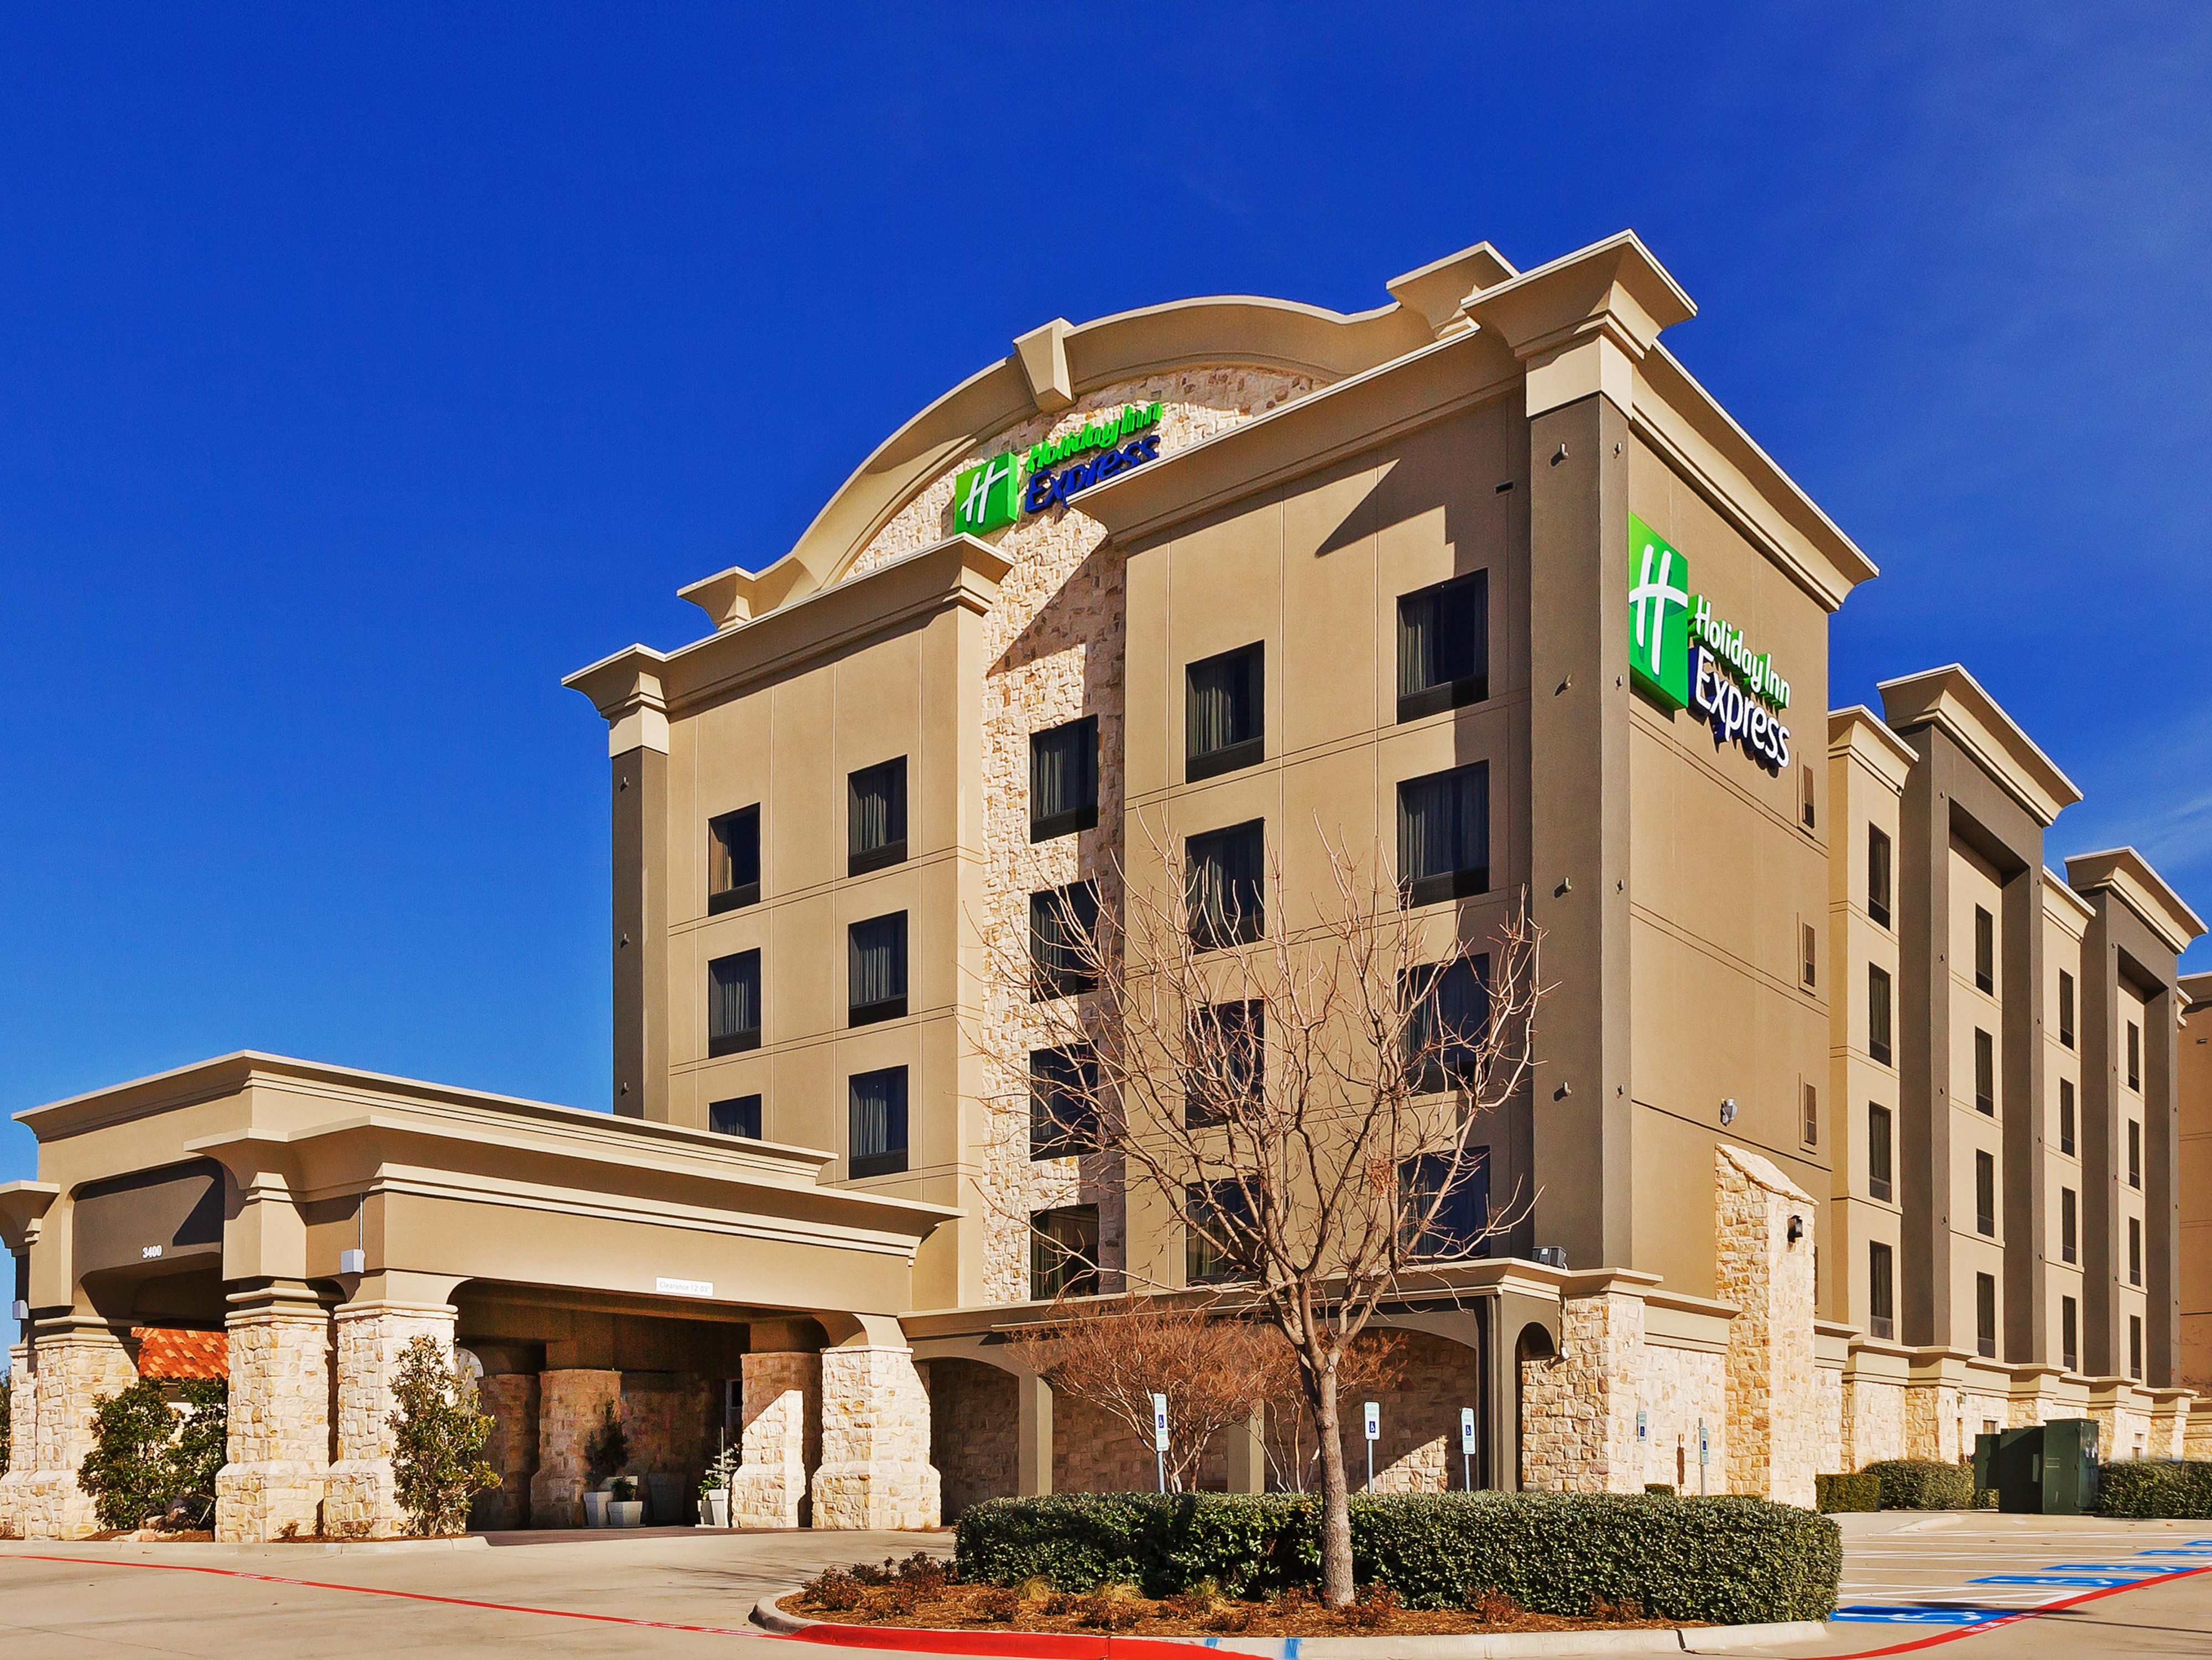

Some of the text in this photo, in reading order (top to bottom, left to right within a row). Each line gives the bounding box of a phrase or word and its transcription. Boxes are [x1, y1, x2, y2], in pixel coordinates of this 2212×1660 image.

[1025, 435, 1161, 514] Express
[1026, 403, 1162, 473] Holiday Inn
[1693, 594, 1791, 708] Holiday Inn
[1695, 645, 1791, 768] Express
[142, 1245, 162, 1258] 3400
[659, 1281, 690, 1290] Clearance
